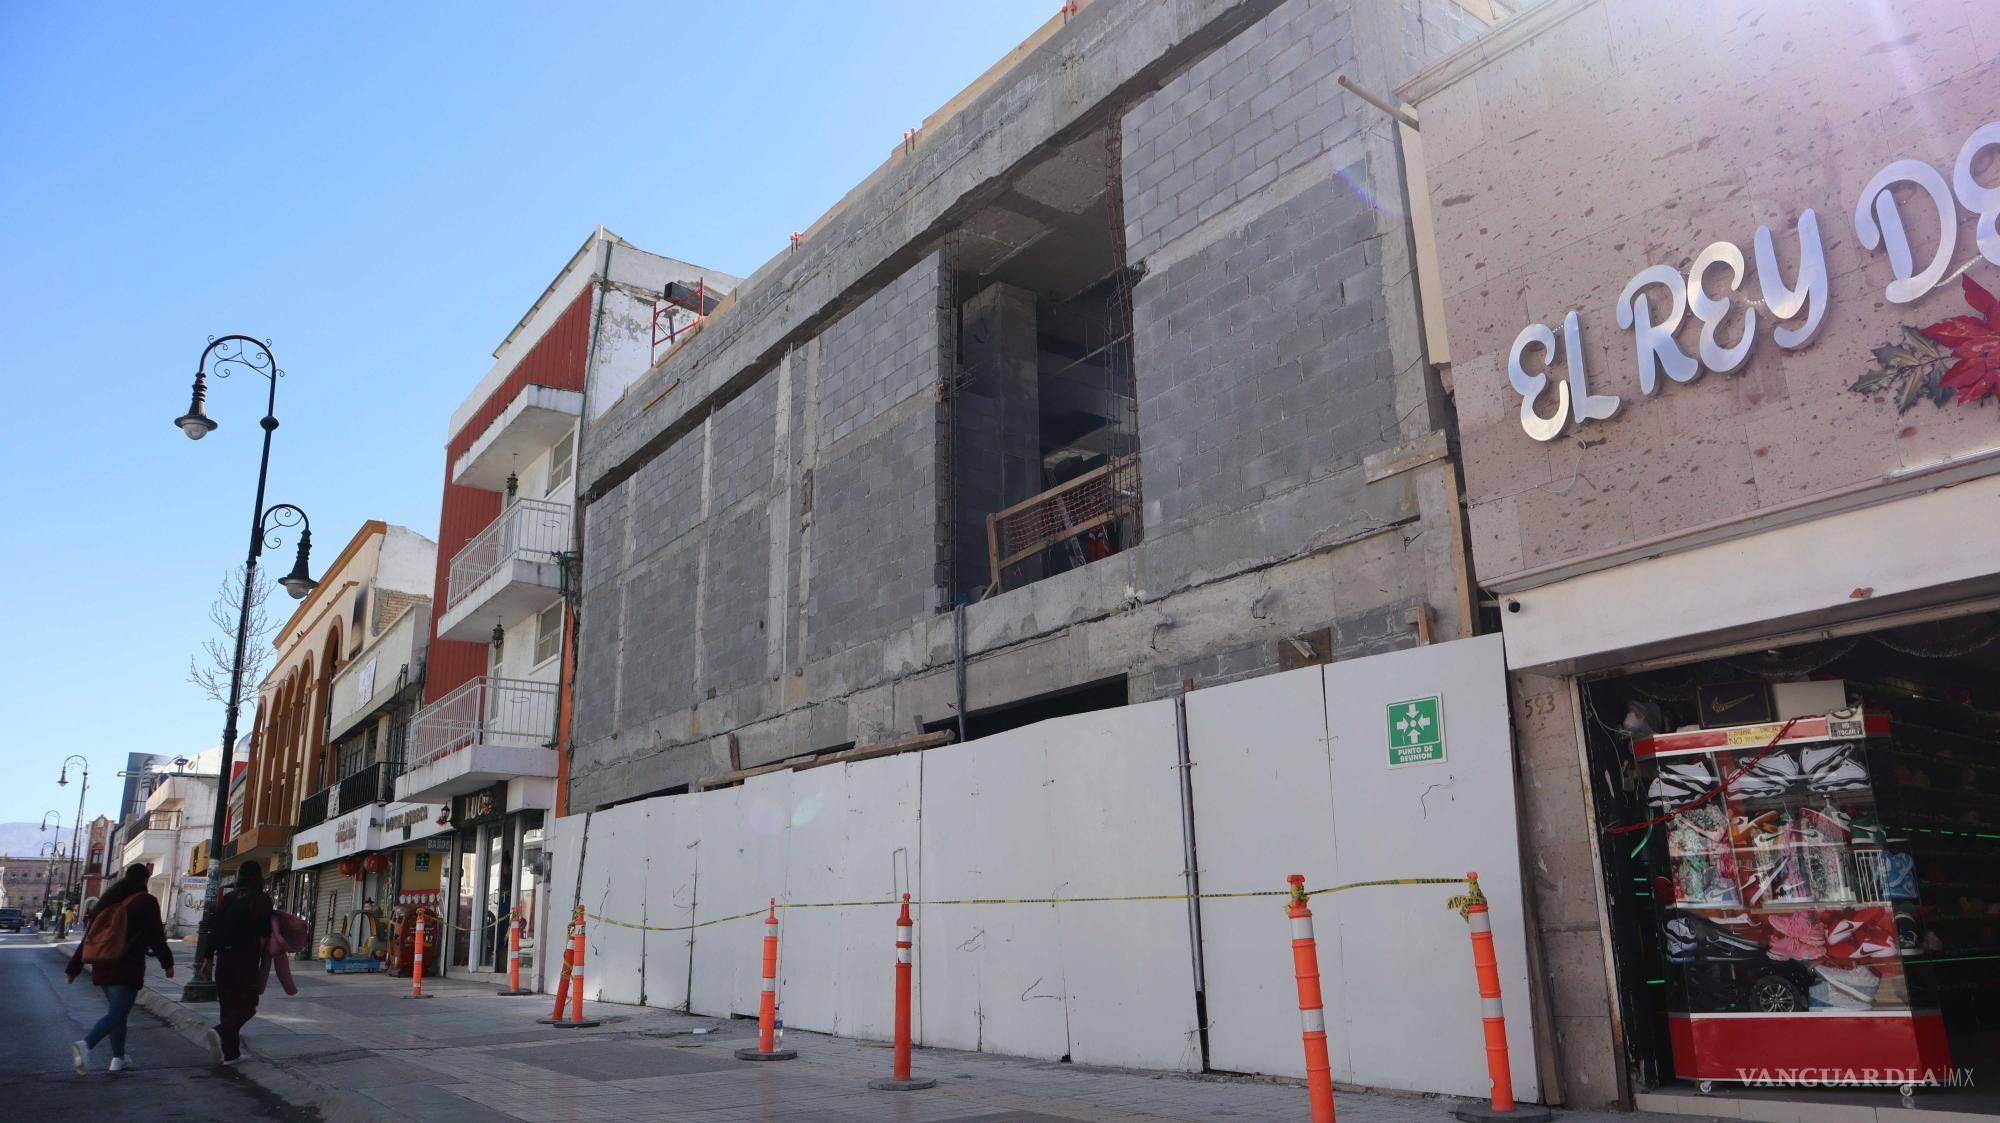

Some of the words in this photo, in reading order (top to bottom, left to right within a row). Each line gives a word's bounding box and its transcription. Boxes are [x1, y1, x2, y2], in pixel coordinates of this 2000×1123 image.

[1508, 310, 1620, 442] EL
[1616, 207, 1829, 395] REY
[1854, 120, 2000, 305] DE
[1524, 694, 1556, 719] 593
[1397, 747, 1422, 756] PUNTO
[1400, 752, 1433, 763] REUNION
